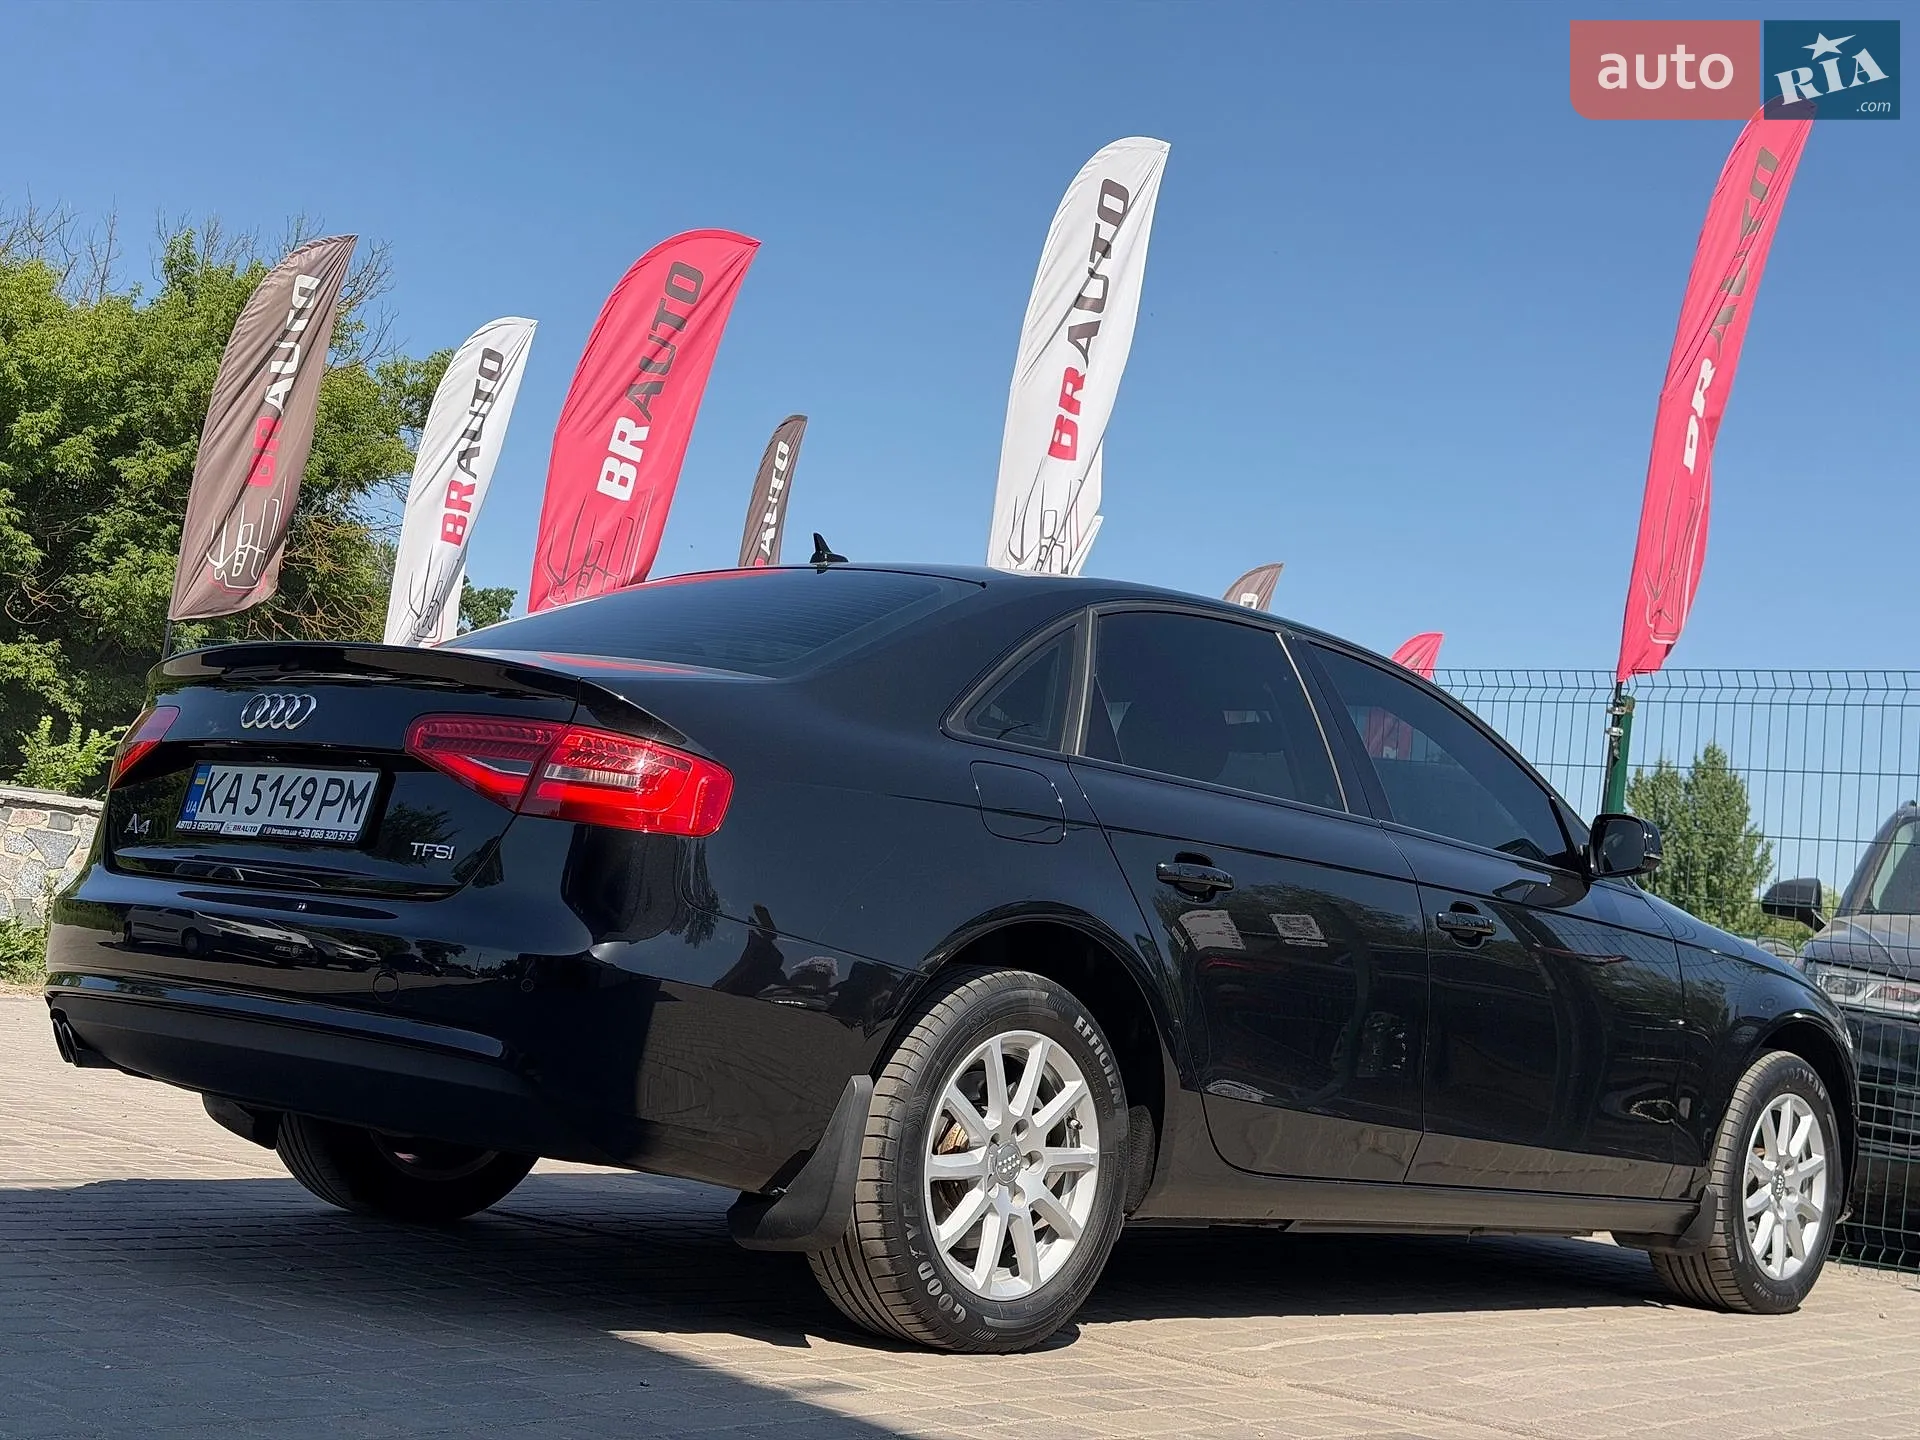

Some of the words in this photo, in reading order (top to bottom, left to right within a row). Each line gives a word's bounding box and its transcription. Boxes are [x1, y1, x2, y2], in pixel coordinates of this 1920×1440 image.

[596, 261, 704, 502] BRAUTO
[1048, 178, 1130, 461] BRAUTO
[441, 347, 504, 547] BRAUTO
[755, 440, 790, 567] AUTO
[124, 813, 152, 834] A4
[185, 800, 197, 813] UA
[410, 842, 455, 860] TFSI
